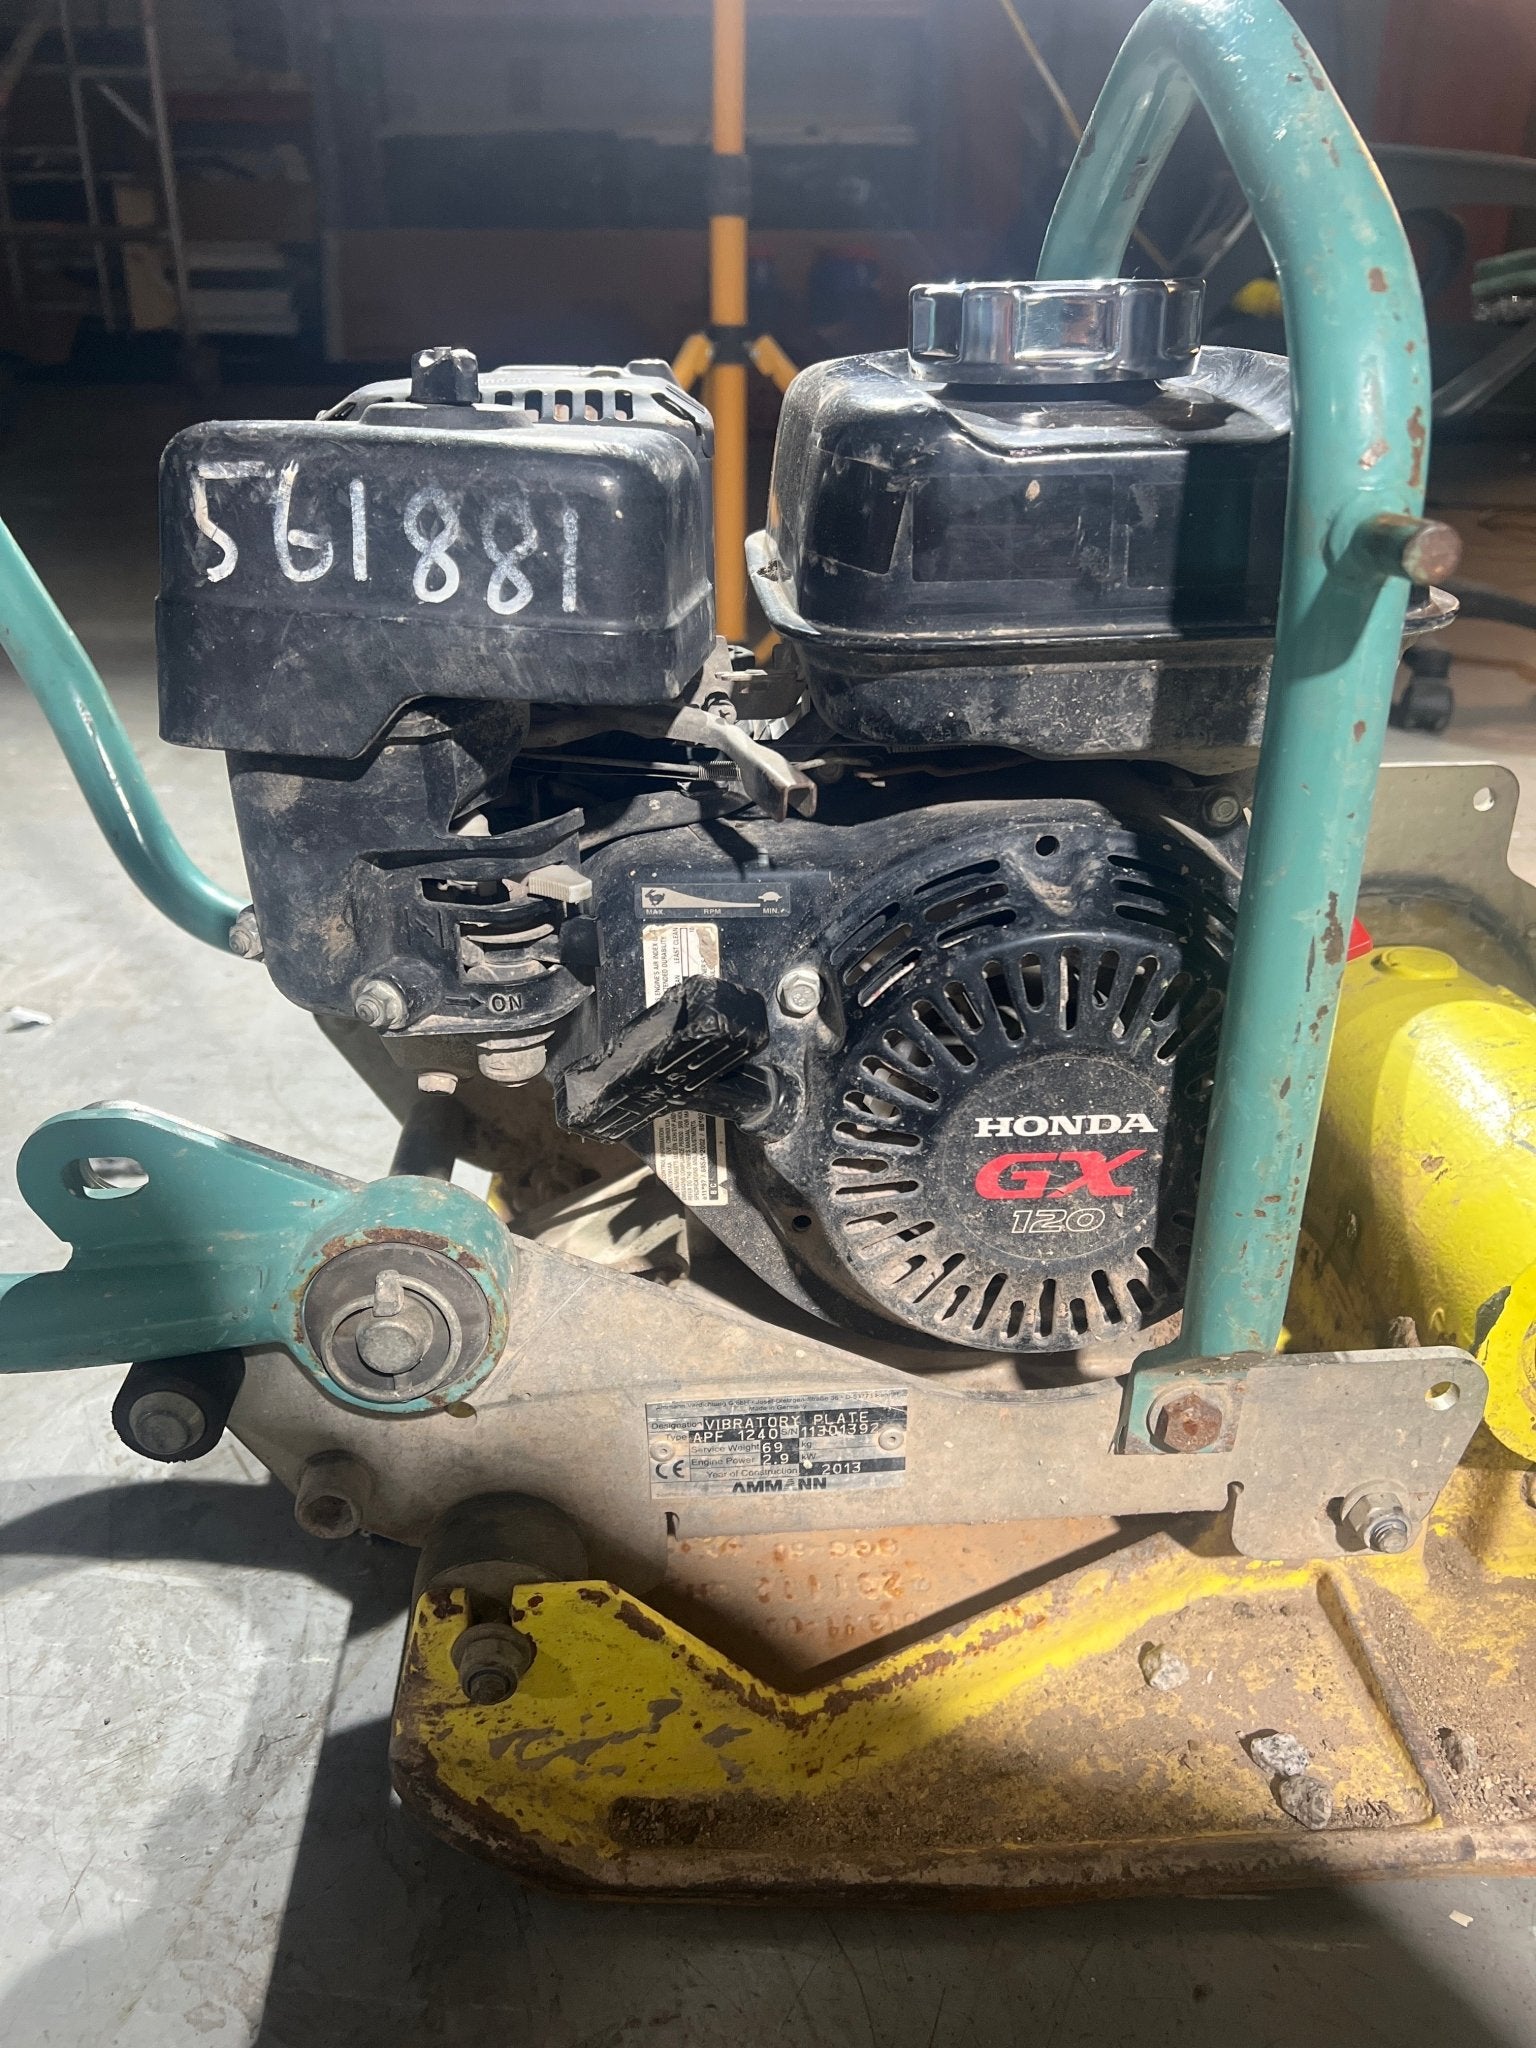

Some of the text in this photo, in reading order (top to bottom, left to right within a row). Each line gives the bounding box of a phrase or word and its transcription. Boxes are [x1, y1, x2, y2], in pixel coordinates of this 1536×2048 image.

[188, 460, 579, 615] 561881
[660, 935, 668, 968] DURABILITY
[488, 992, 524, 1014] ON
[974, 1113, 1158, 1138] HONDA
[975, 1149, 1148, 1200] GX
[1011, 1207, 1106, 1234] 120
[651, 1411, 869, 1431] Designation VIBRATORY PLATE
[667, 1433, 688, 1442] Type
[692, 1430, 724, 1443] APF
[738, 1428, 778, 1441] 1240
[781, 1427, 798, 1436] S/N
[691, 1441, 812, 1453] Service Weight 69 kg
[691, 1453, 817, 1467] Engine Power 2.9 kW
[706, 1471, 727, 1479] Year
[740, 1467, 798, 1477] Construction
[822, 1462, 862, 1475] 2013
[732, 1477, 828, 1494] AMMANN
